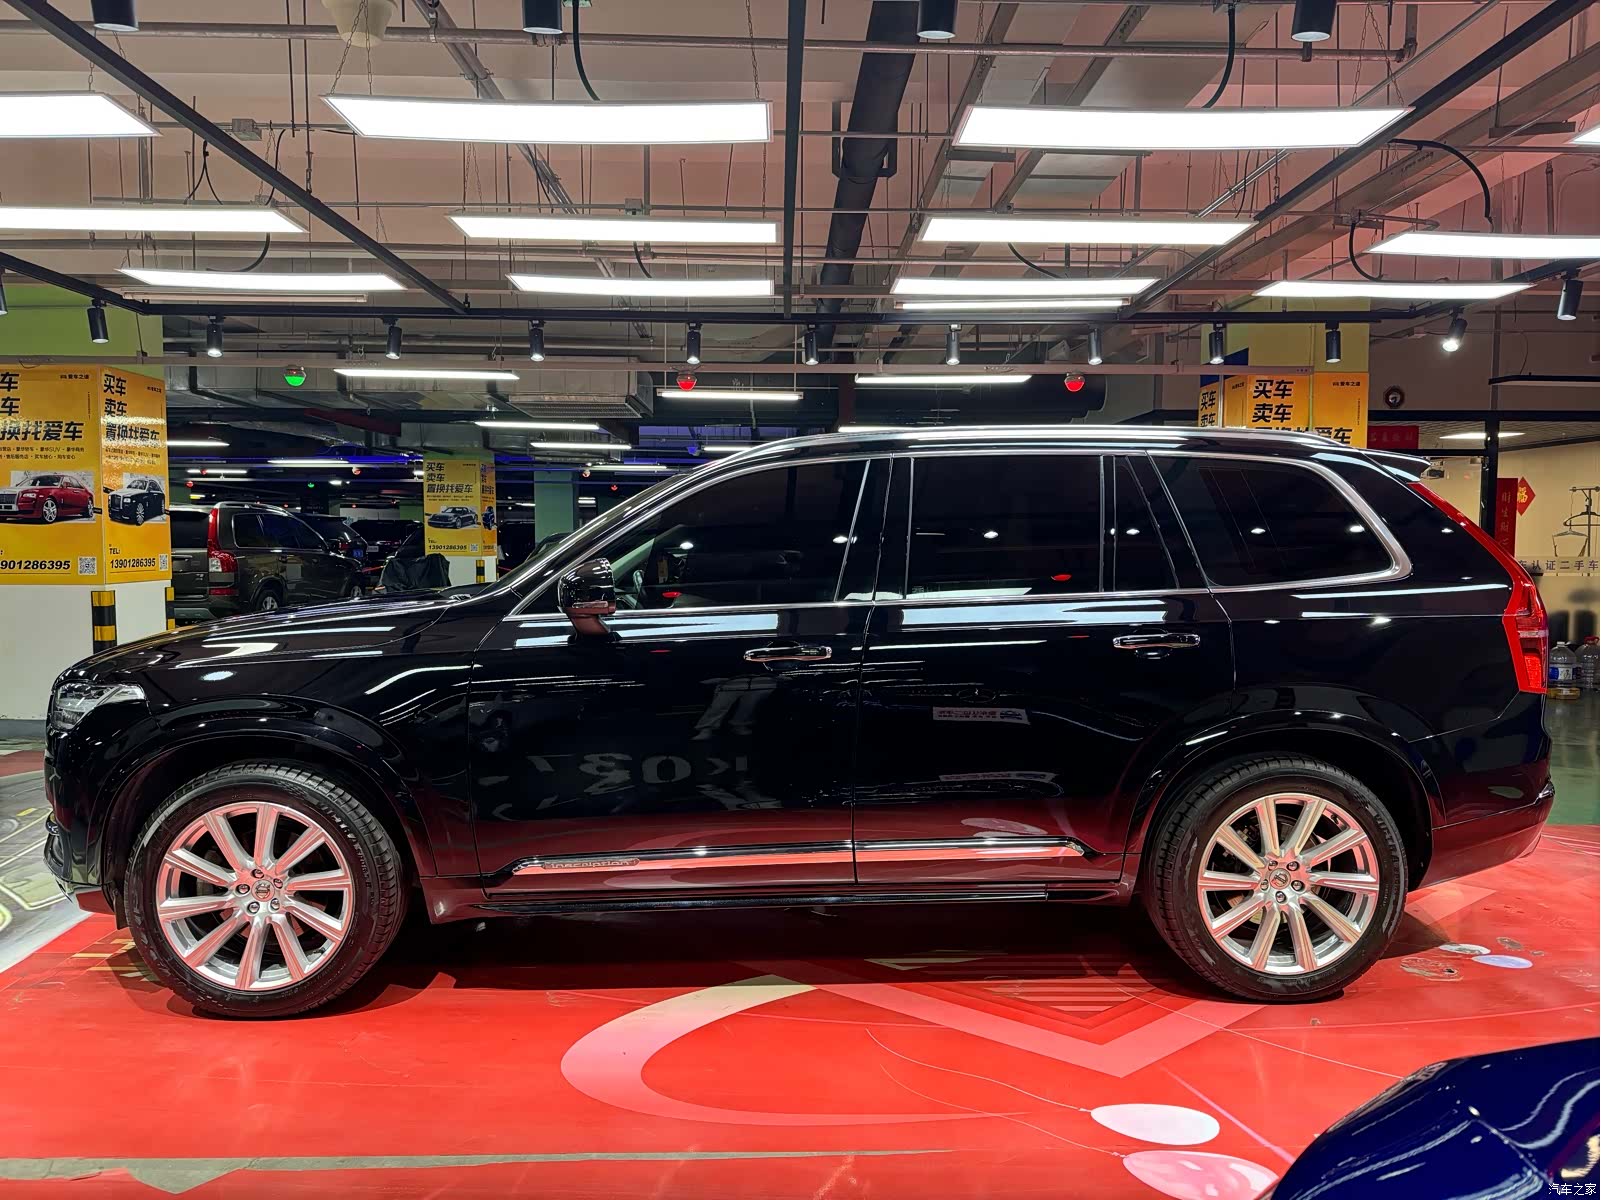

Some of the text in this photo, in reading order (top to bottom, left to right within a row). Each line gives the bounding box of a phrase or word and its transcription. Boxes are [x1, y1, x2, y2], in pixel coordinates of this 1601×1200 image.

[103, 374, 127, 396] 买车
[1253, 380, 1294, 399] 买车
[104, 398, 128, 418] 卖车
[1201, 390, 1217, 411] 买车
[1252, 403, 1294, 423] 卖车
[426, 462, 445, 471] 买车
[426, 473, 445, 482] 卖车
[427, 484, 473, 493] 置换找爱车
[110, 558, 156, 569] 13901286395
[550, 860, 630, 869] inscription
